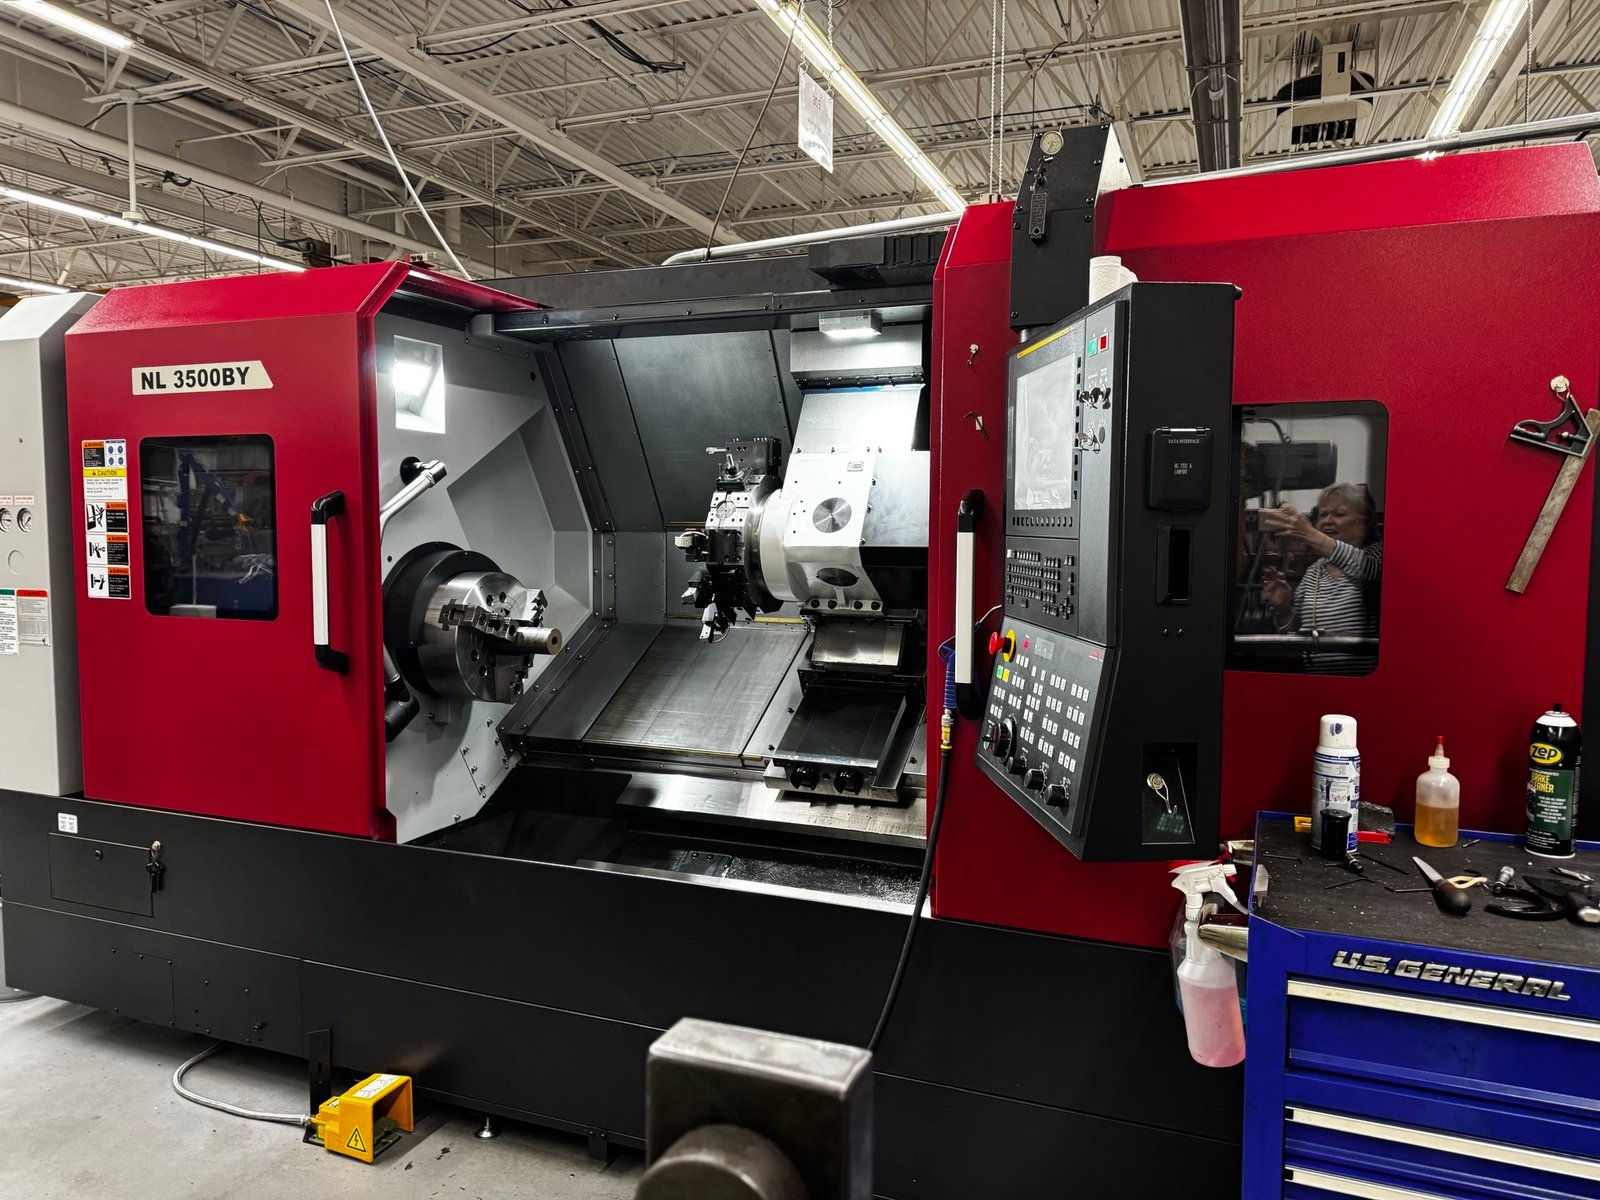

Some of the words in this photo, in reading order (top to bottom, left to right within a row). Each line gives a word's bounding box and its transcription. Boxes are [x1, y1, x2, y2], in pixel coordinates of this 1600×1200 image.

[141, 371, 167, 390] NL
[173, 366, 250, 389] 3500BY
[1530, 780, 1555, 794] CLEANER
[1531, 772, 1551, 784] BRAKE
[1332, 950, 1391, 974] U.S.
[1394, 959, 1571, 1001] GENERAL
